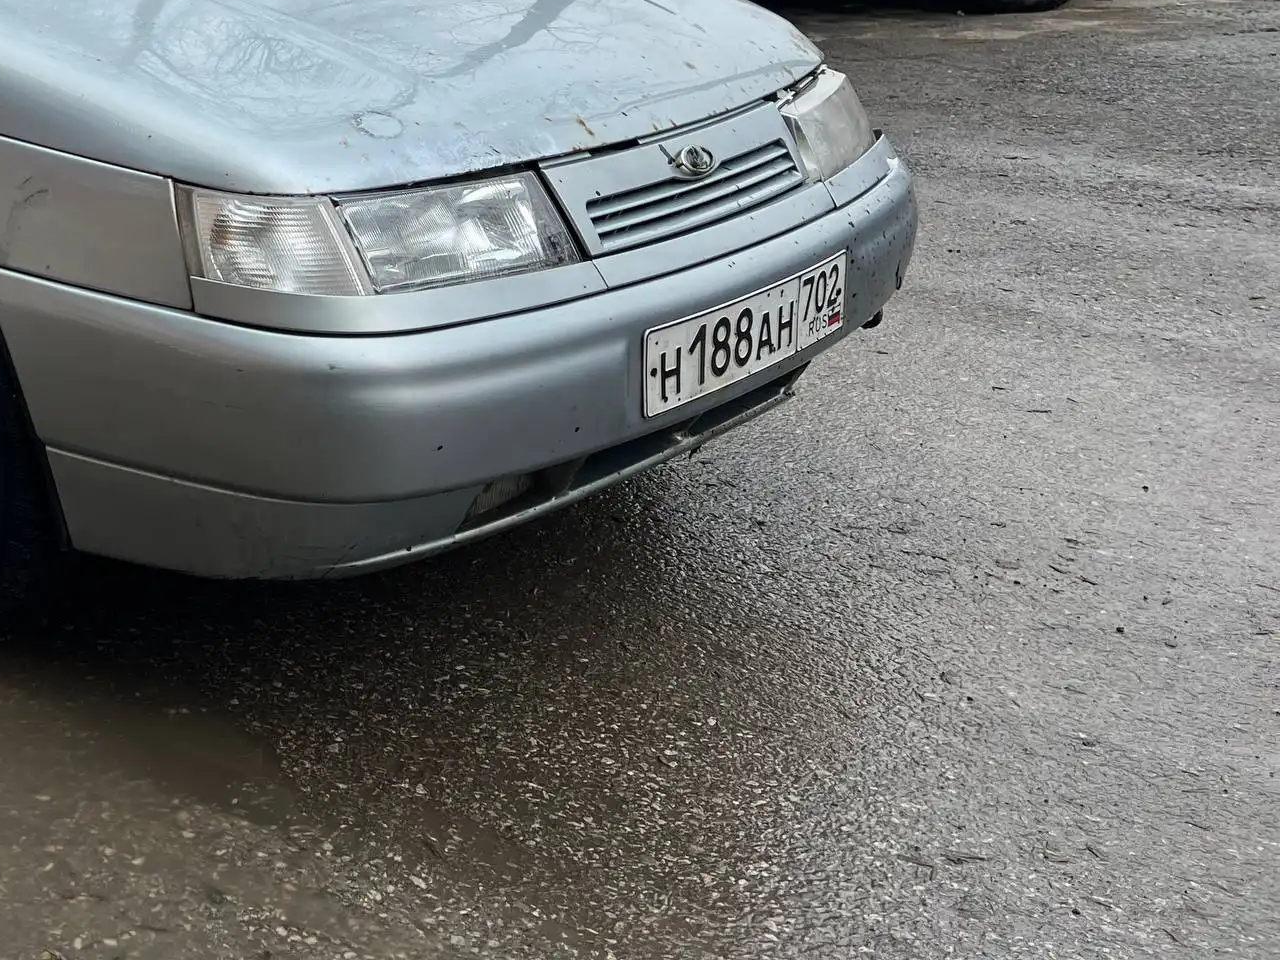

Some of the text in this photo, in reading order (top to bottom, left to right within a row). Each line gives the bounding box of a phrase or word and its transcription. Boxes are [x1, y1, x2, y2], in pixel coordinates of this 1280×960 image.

[660, 263, 840, 401] Н188АН 702
[808, 313, 828, 337] RUS
